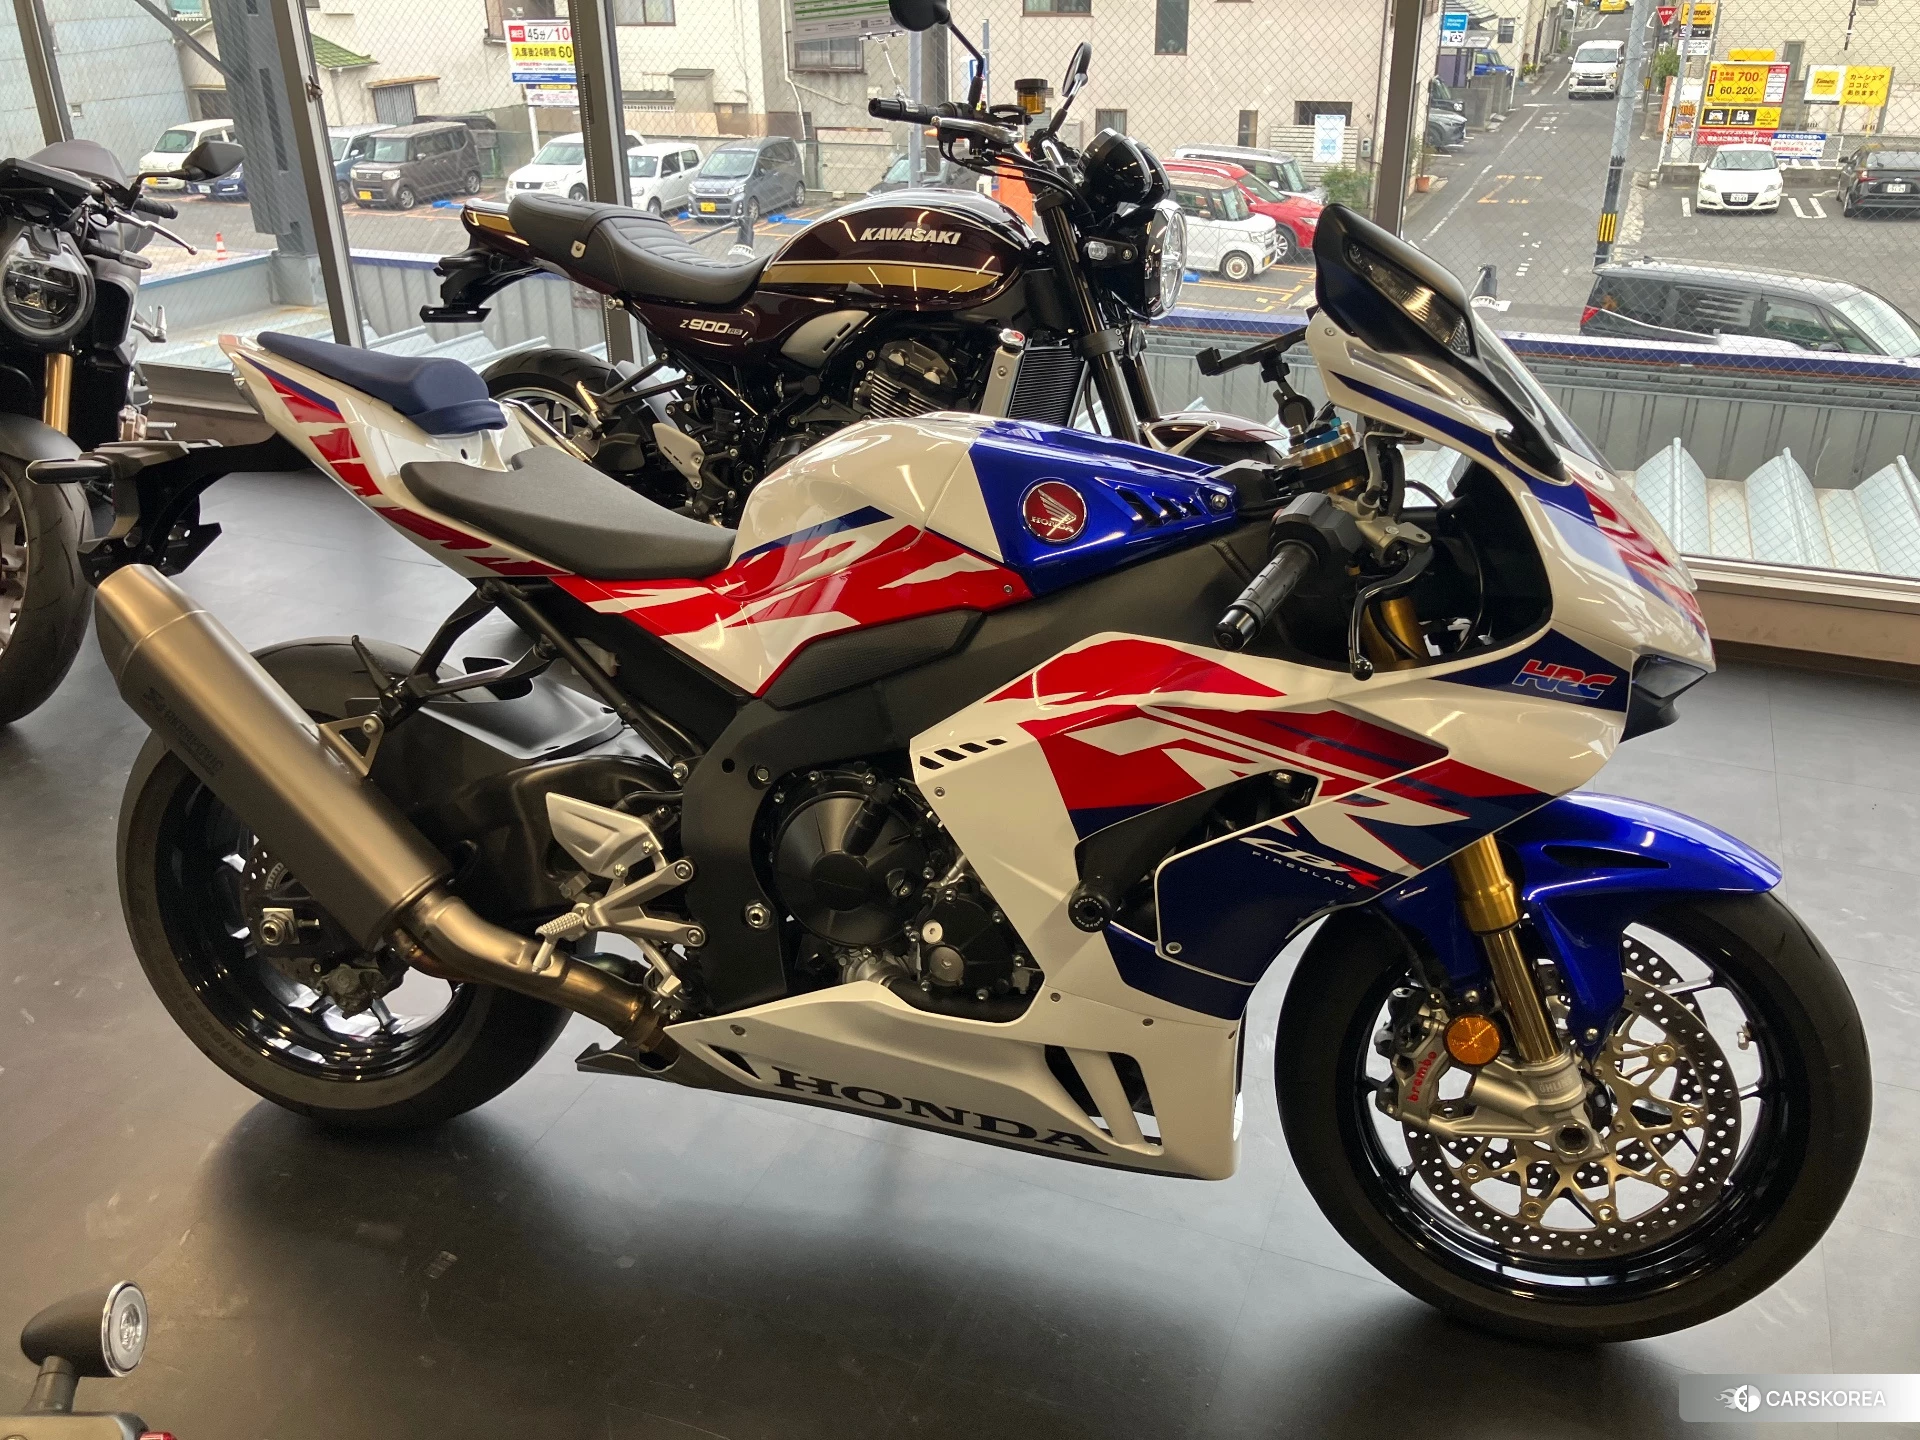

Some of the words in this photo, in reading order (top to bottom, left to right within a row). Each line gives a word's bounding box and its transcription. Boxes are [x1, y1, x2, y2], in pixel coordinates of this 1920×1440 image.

[860, 227, 962, 245] KAWASAKI
[1031, 516, 1075, 533] HONDA
[1512, 659, 1617, 699] HRC
[1252, 850, 1357, 890] FIREBLADE
[1406, 1051, 1437, 1102] brembo
[771, 1066, 1109, 1156] HONDA
